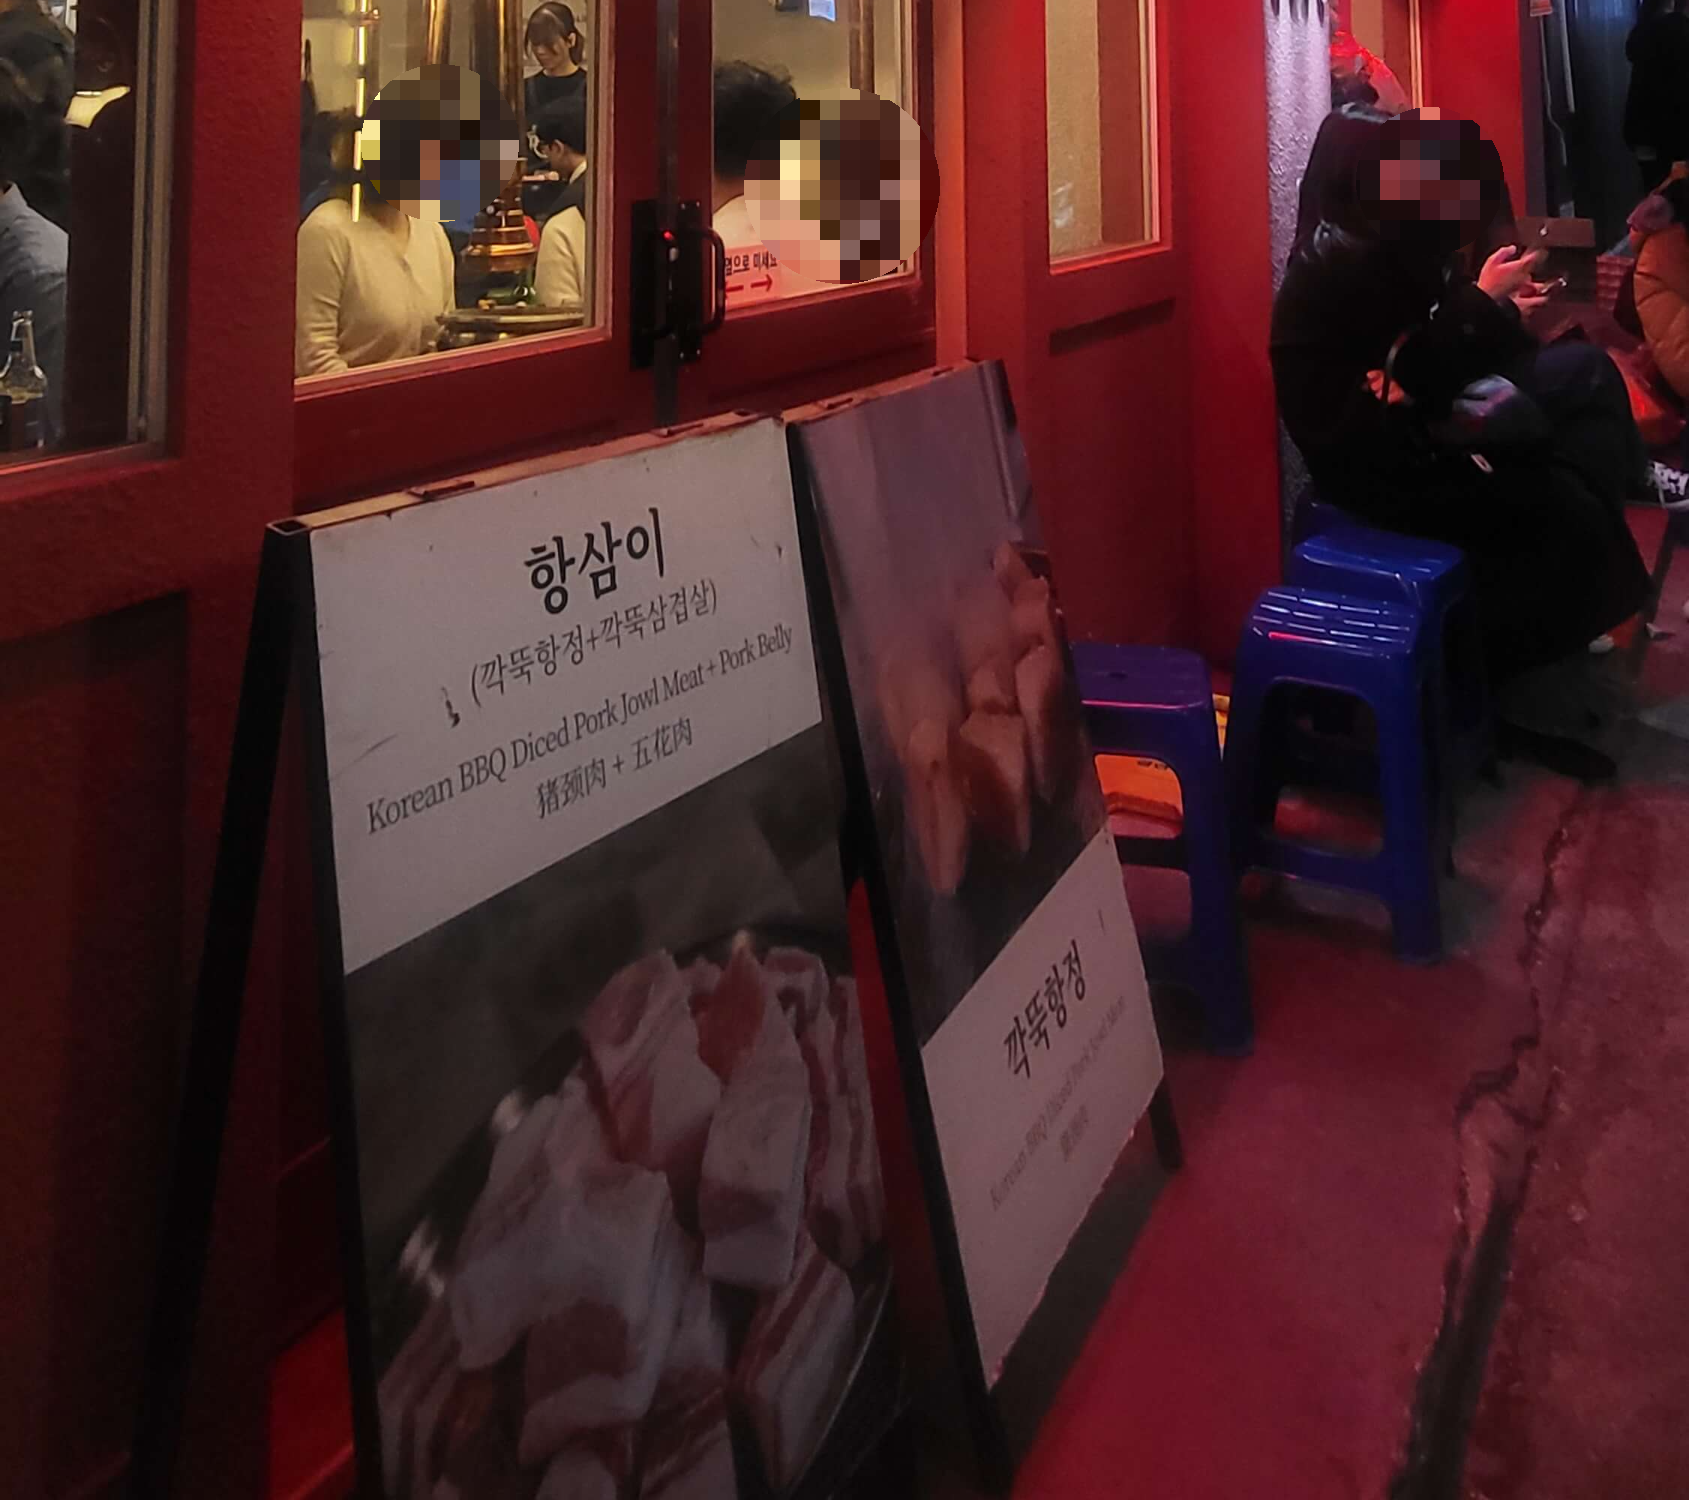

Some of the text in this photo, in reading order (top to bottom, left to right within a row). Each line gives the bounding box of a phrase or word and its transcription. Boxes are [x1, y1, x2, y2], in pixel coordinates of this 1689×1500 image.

[524, 507, 664, 615] 항삼이
[366, 777, 454, 834] Korean
[458, 747, 507, 792] BBQ
[511, 716, 570, 769] Diced
[574, 698, 618, 741] Pork
[620, 677, 660, 725] Jowl
[662, 664, 705, 702] Meat
[719, 638, 757, 676] Pork
[757, 623, 793, 658] Belly
[630, 717, 693, 772] 五花肉
[1004, 939, 1086, 1079] 깍뚝항정
